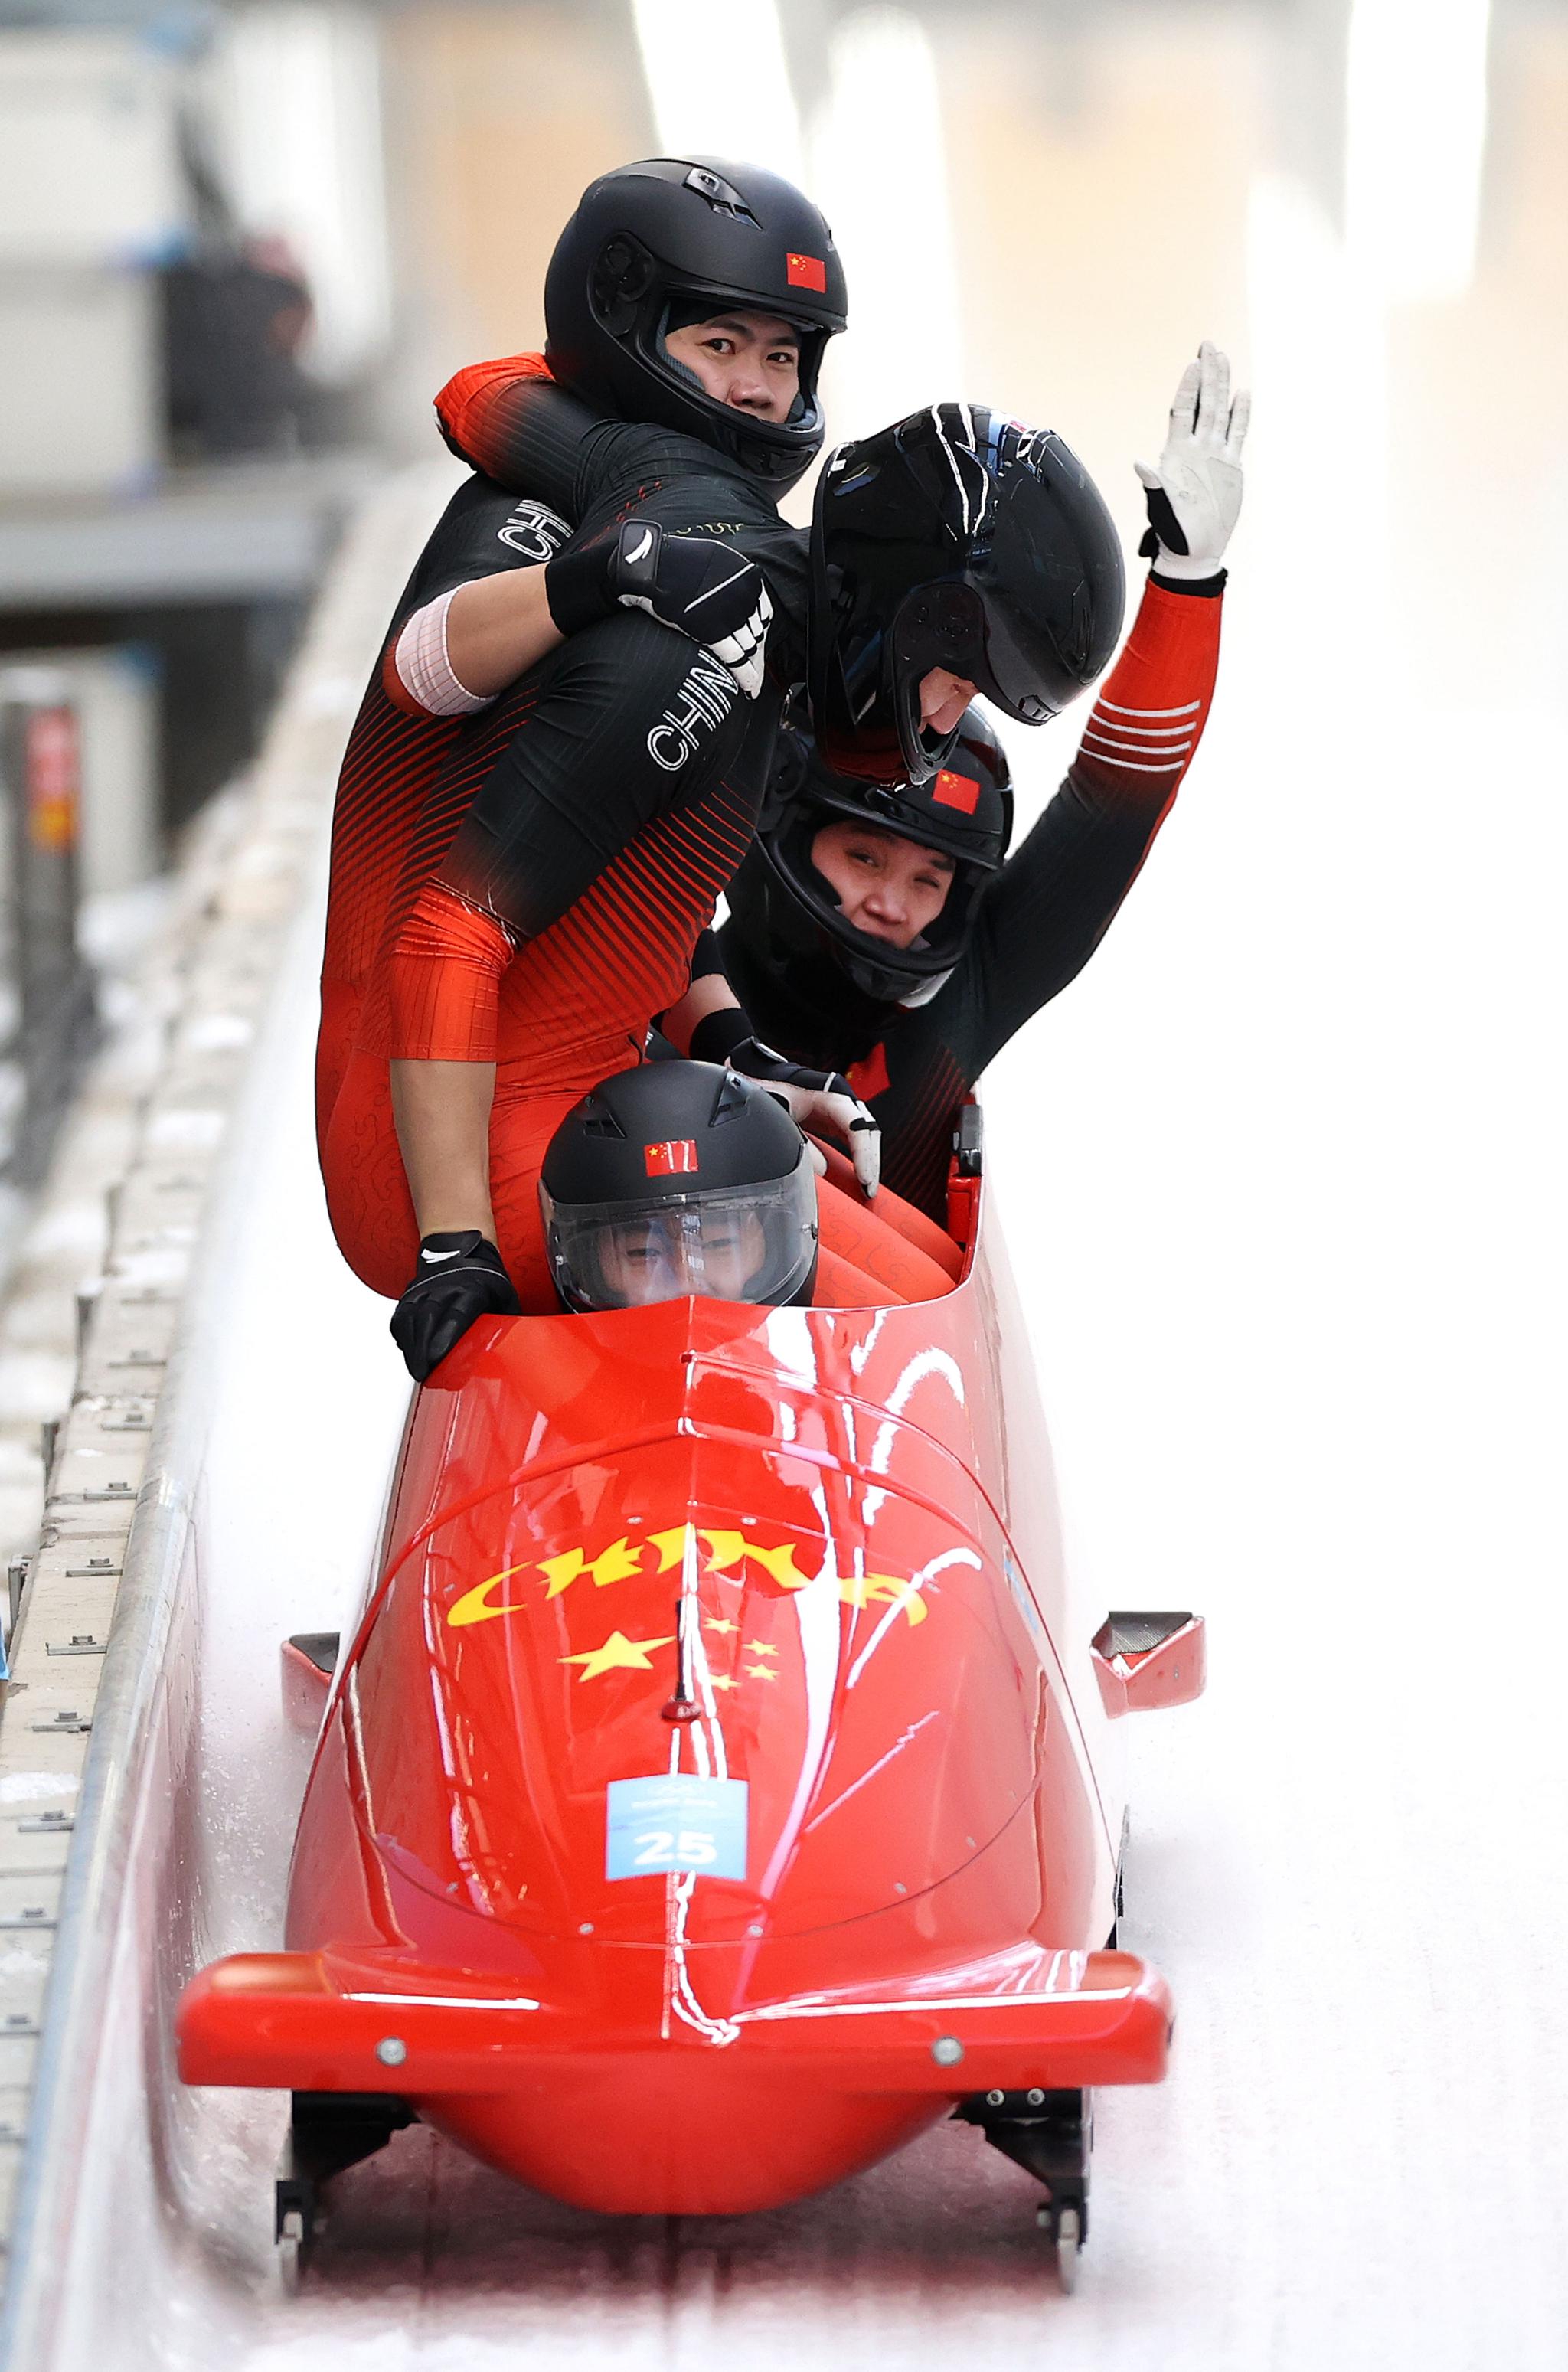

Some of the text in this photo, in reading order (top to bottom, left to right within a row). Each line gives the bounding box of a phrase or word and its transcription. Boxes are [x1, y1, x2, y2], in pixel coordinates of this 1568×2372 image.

[497, 499, 575, 561] CHI
[647, 649, 738, 771] CHIN
[447, 1523, 929, 1628] CHINA
[633, 1831, 717, 1865] 25
